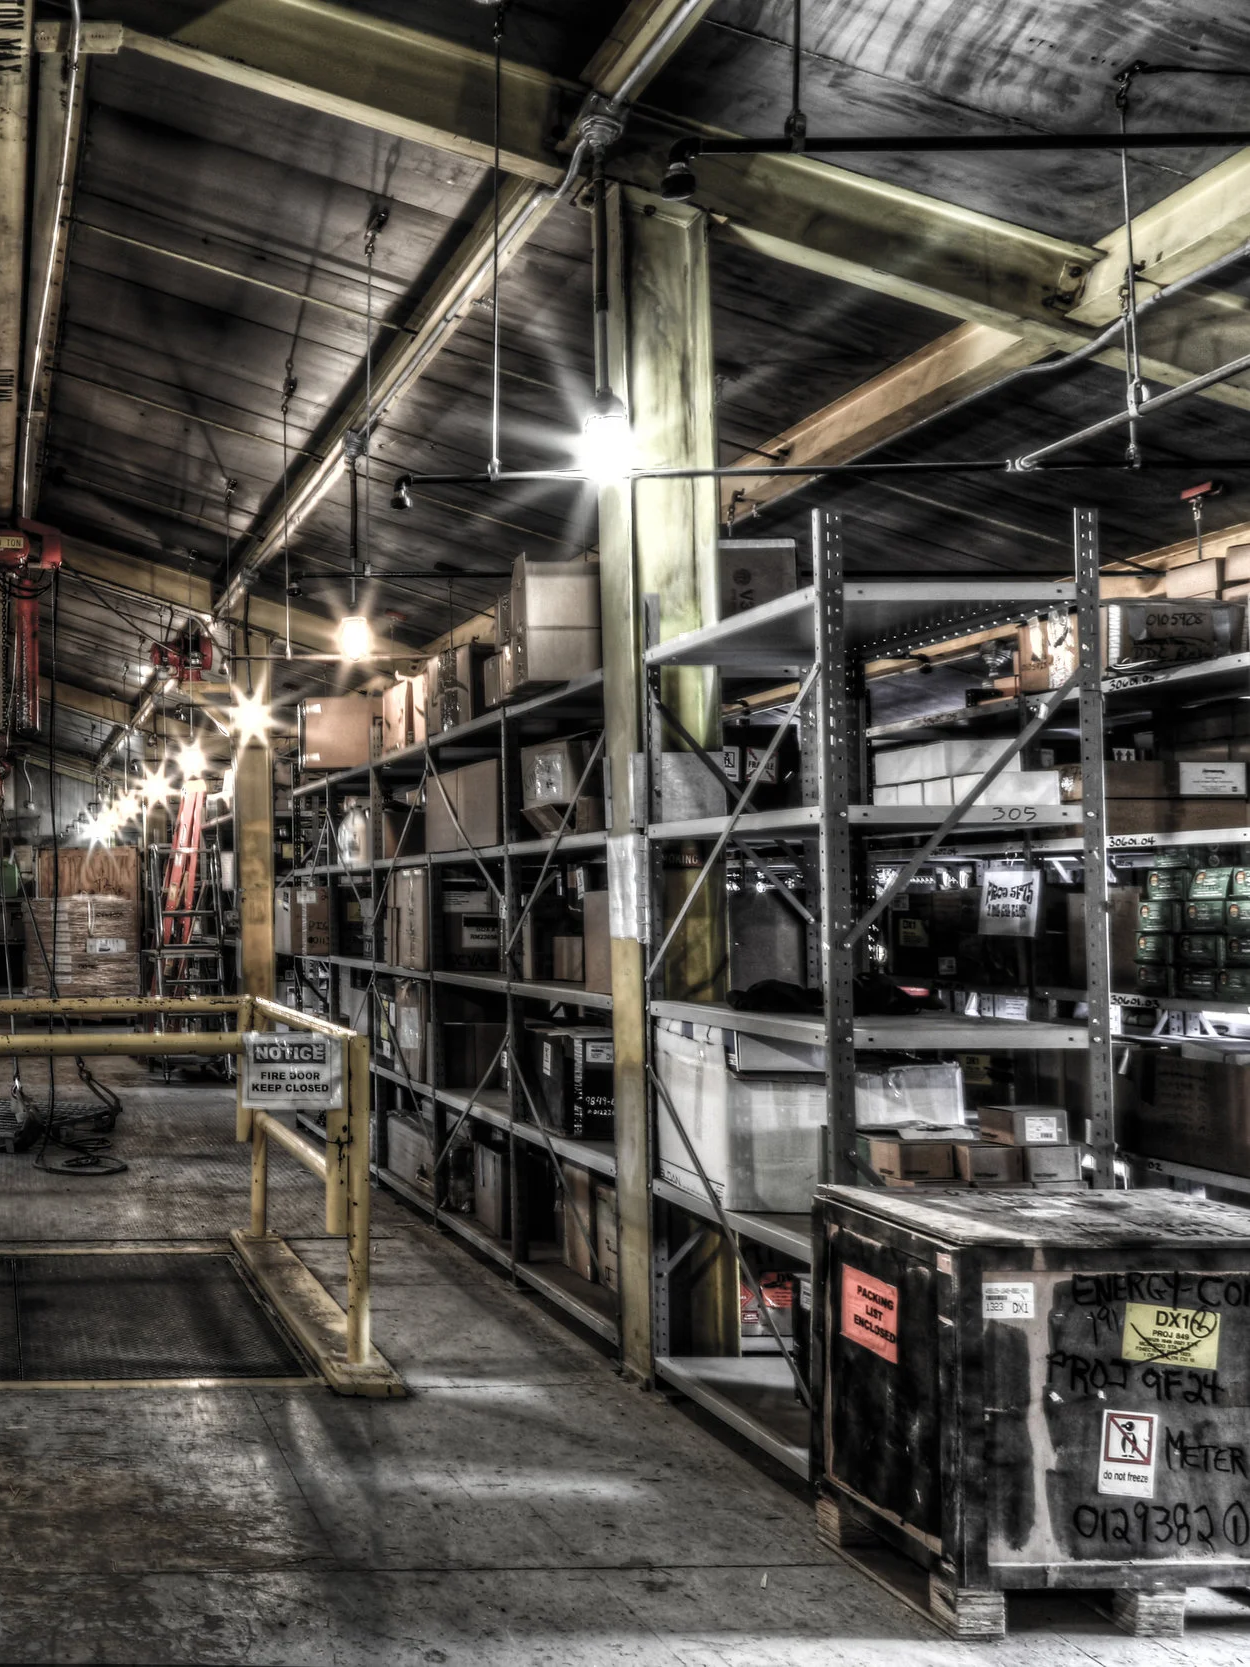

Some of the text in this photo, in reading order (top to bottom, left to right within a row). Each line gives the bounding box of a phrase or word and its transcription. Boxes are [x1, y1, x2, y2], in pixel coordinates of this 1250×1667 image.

[6, 539, 22, 547] TON
[992, 806, 1038, 822] 305
[1108, 836, 1157, 848] 30601.04
[255, 1045, 325, 1061] NOTICE
[260, 1071, 320, 1080] FIRE DOOR
[251, 1083, 329, 1093] KEEP CLOSED
[1072, 1271, 1250, 1308] ENERGY-CO
[856, 1285, 895, 1311] PACKING
[865, 1304, 884, 1322] LIST
[1012, 1302, 1029, 1314] DX1
[1155, 1309, 1190, 1330] DX1
[853, 1314, 896, 1344] ENCLOSED
[1152, 1329, 1190, 1341] PROJ 849
[1046, 1352, 1225, 1406] PROJ 9F24
[1164, 1426, 1247, 1475] METER
[1103, 1470, 1149, 1483] do not freeze
[1073, 1501, 1215, 1552] 0129382
